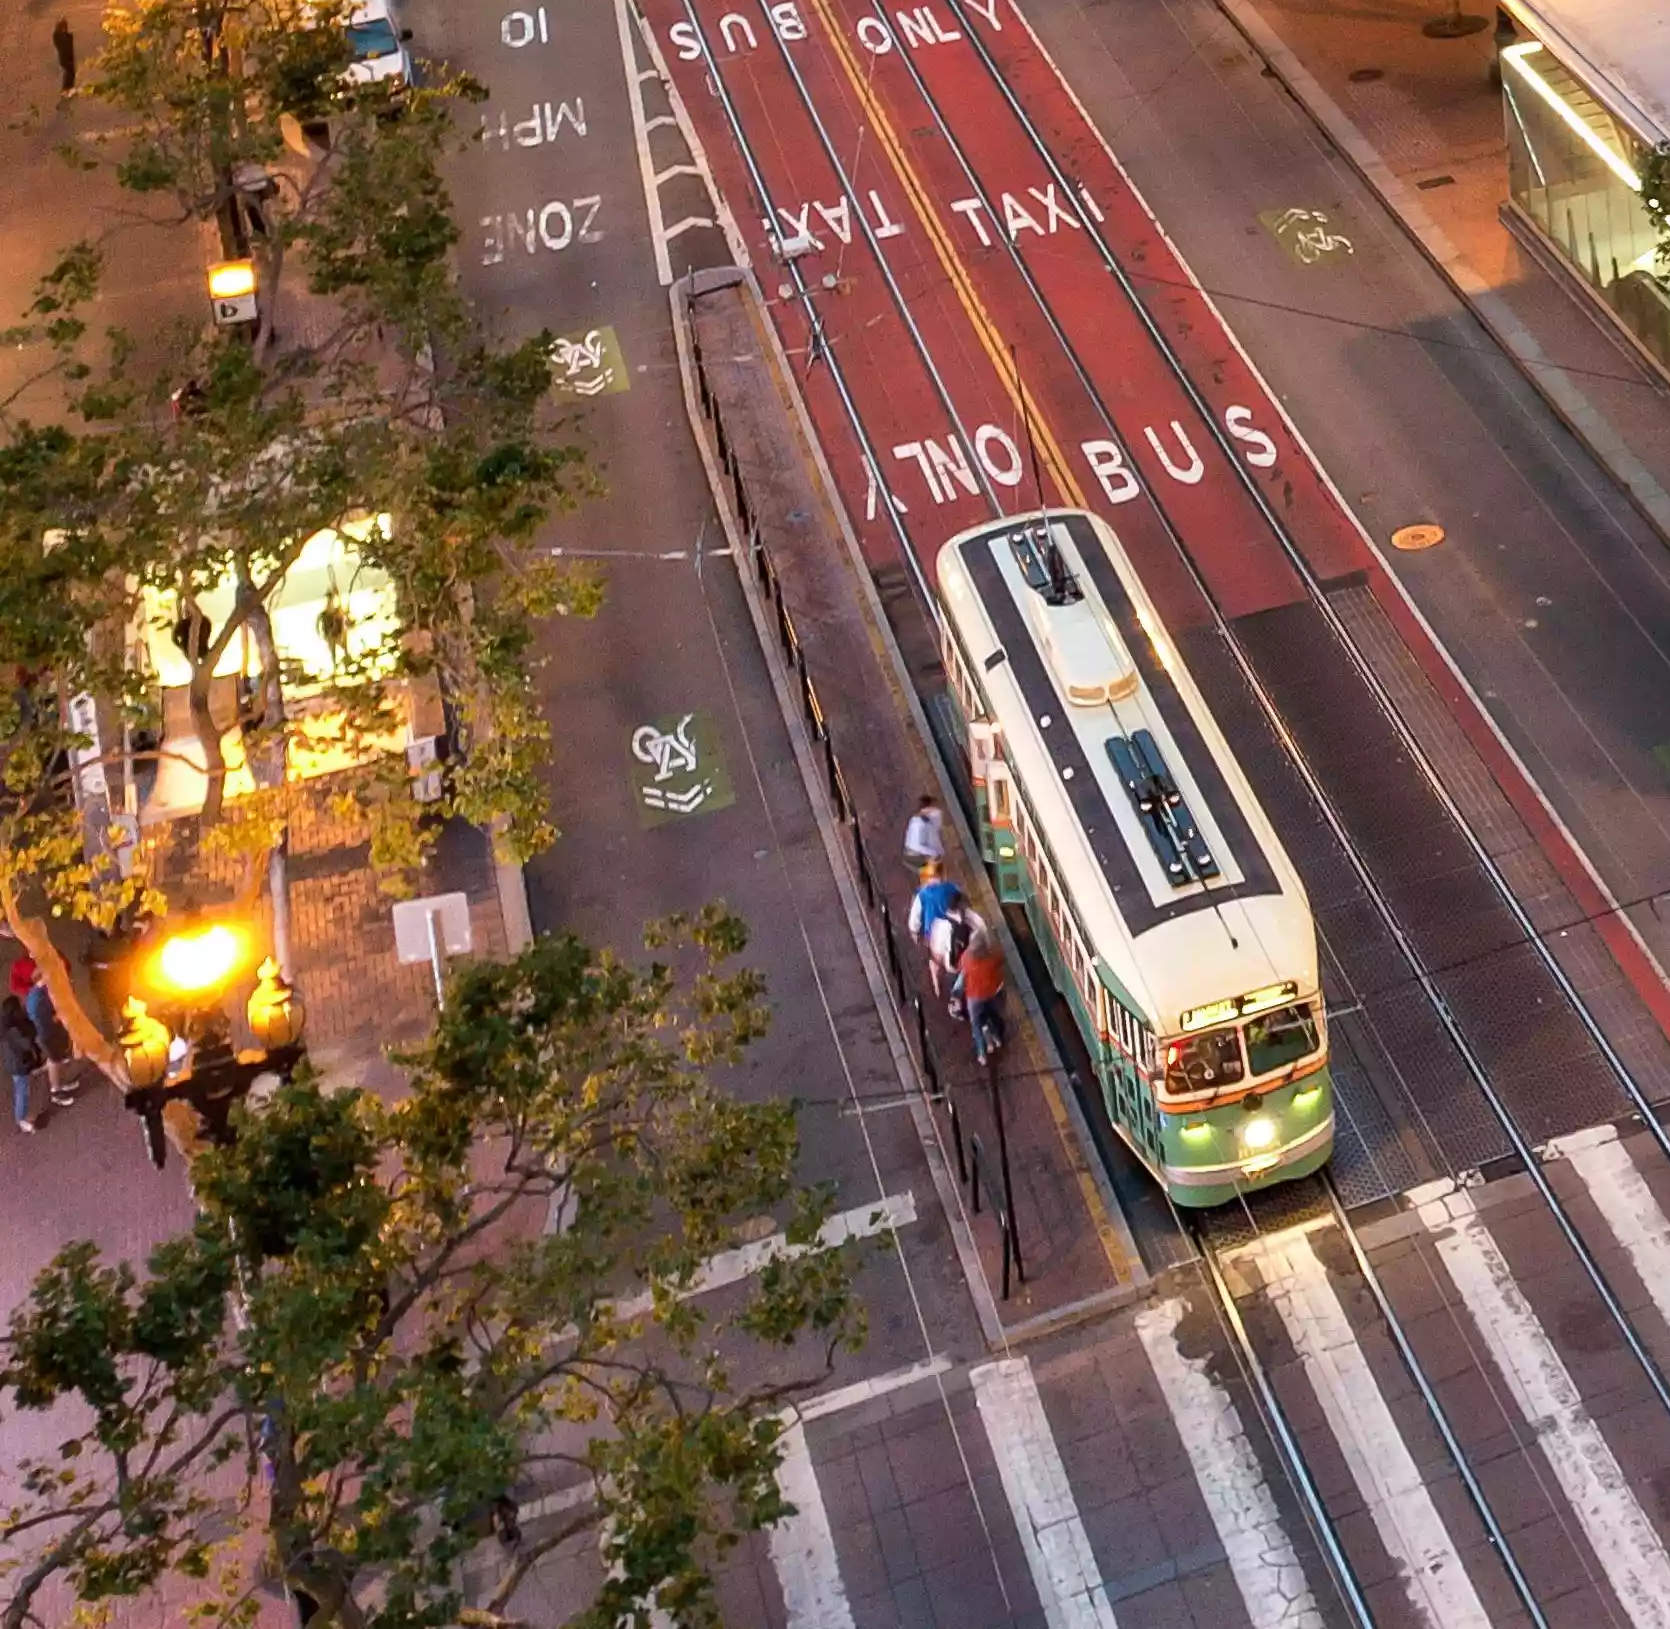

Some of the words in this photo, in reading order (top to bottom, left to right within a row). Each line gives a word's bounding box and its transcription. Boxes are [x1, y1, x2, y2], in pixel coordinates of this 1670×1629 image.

[501, 6, 549, 47] 10
[667, 2, 806, 62] BUS
[481, 96, 587, 155] MPH
[478, 194, 604, 266] ZONE
[950, 181, 1104, 247] TAXI
[861, 422, 1025, 519] ONLY
[1080, 405, 1277, 506] BUS
